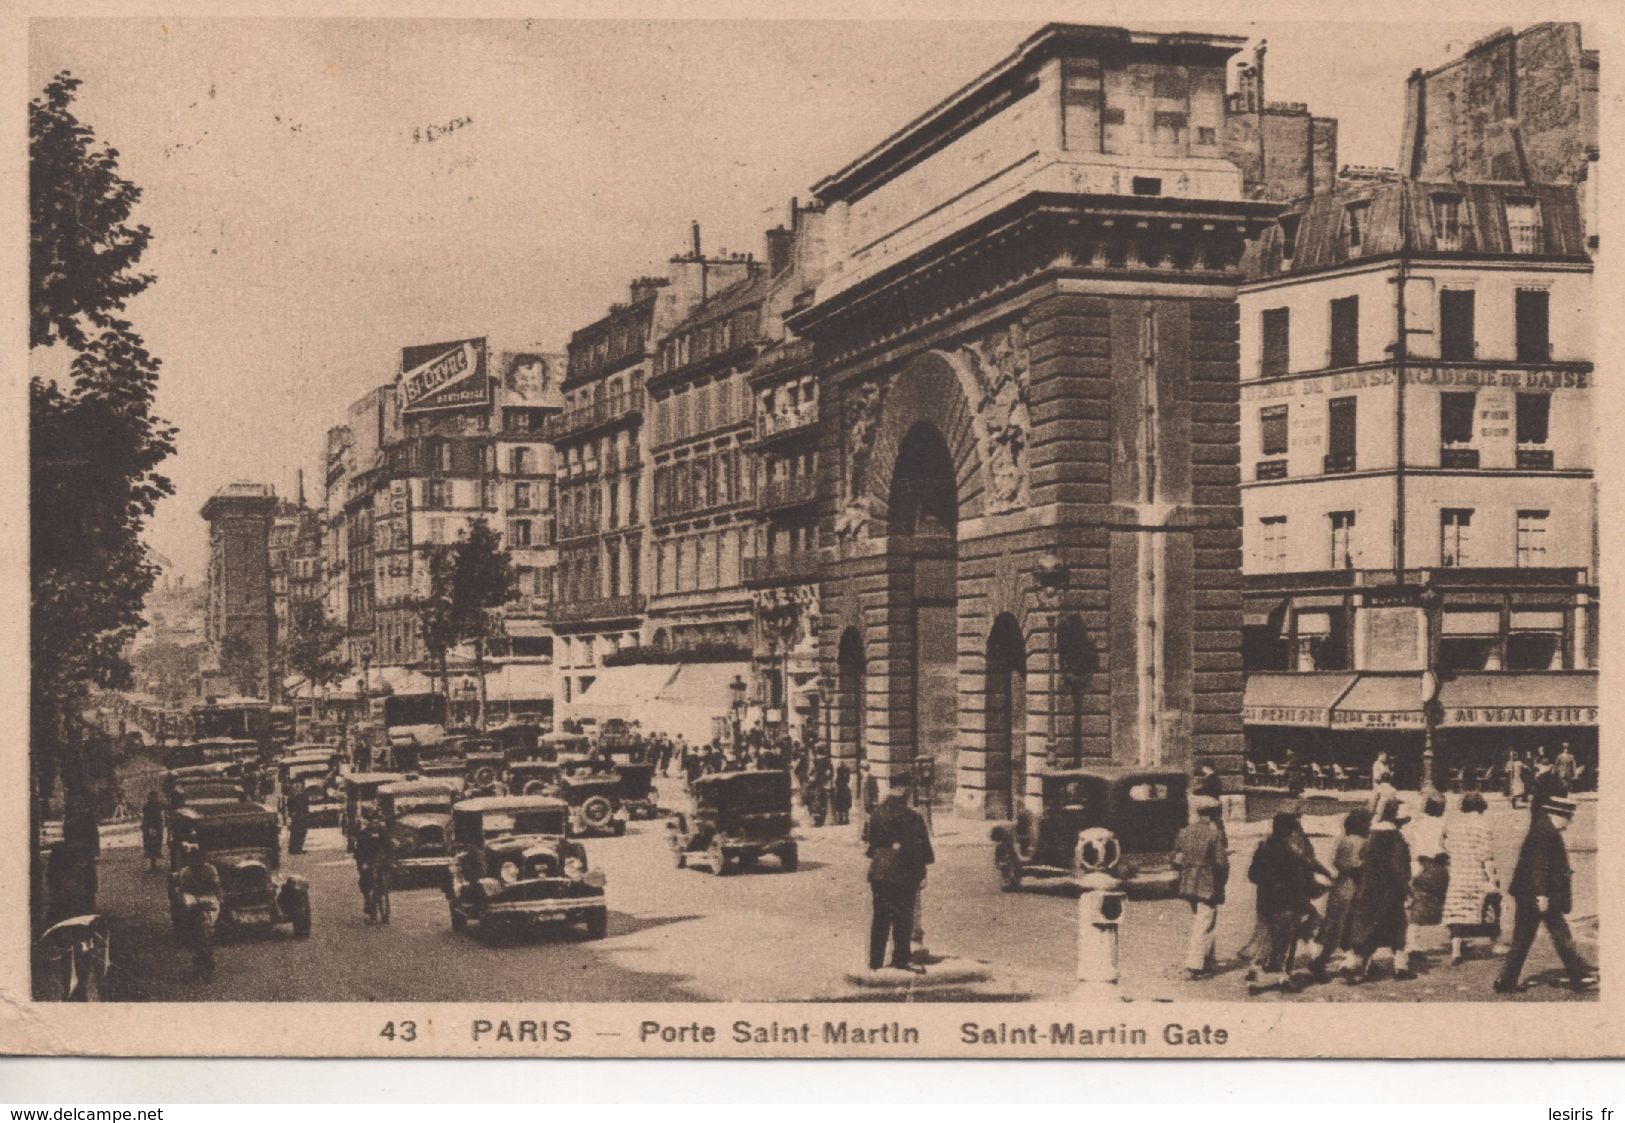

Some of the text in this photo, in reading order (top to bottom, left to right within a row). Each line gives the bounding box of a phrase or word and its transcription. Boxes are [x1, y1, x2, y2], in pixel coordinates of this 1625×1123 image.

[1331, 368, 1394, 391] DANSE
[1500, 373, 1521, 386] DE
[1526, 371, 1589, 389] DANSE
[1532, 709, 1581, 722] PETIT
[381, 1021, 417, 1041] 43
[473, 1020, 572, 1042] PARIS
[641, 1021, 716, 1042] Porte
[1164, 1023, 1229, 1045] Gate
